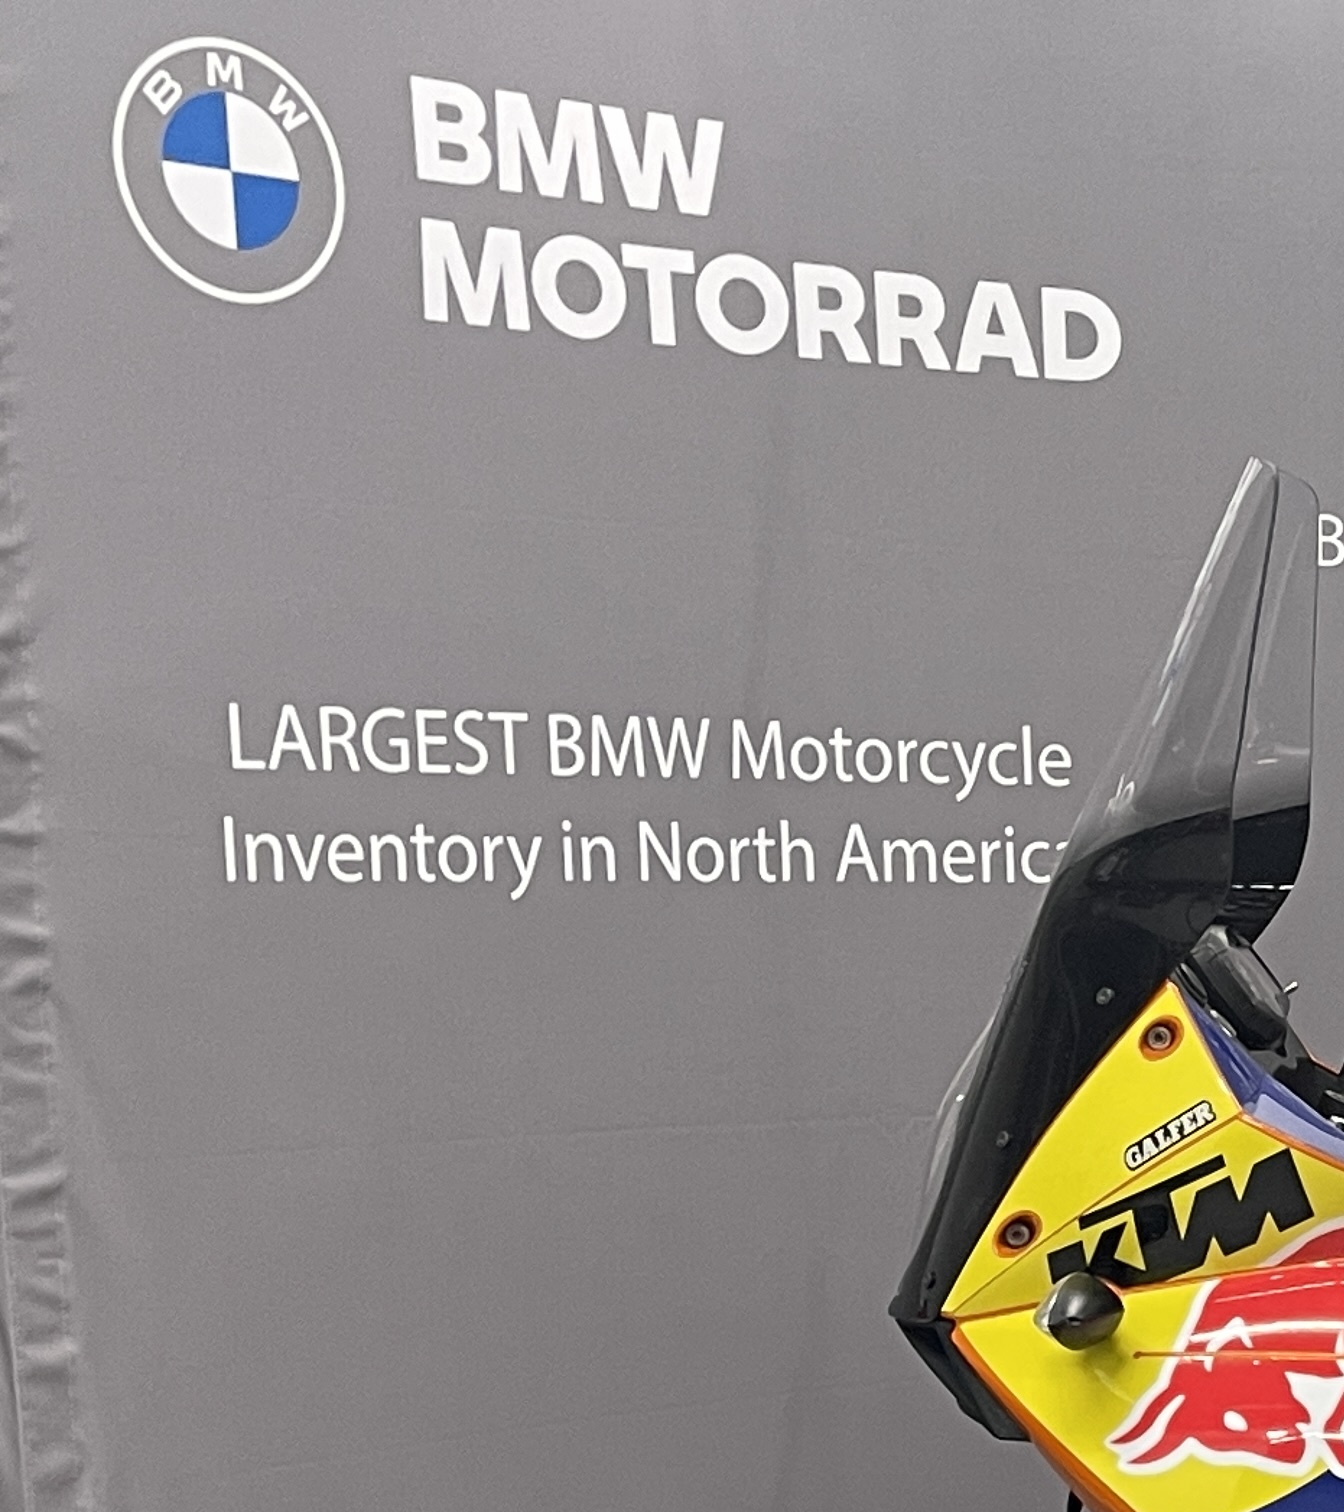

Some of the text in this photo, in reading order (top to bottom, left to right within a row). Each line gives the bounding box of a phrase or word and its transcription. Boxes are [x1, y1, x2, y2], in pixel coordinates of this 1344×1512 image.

[142, 52, 309, 133] BMW
[410, 75, 723, 216] BMW
[421, 217, 1121, 382] MOTORRAD
[229, 703, 1071, 801] LARGEST BMW Motorcycle
[224, 816, 1068, 900] Inventory in North Americ
[1127, 1102, 1214, 1168] GALFER
[1047, 1147, 1315, 1287] KTM
